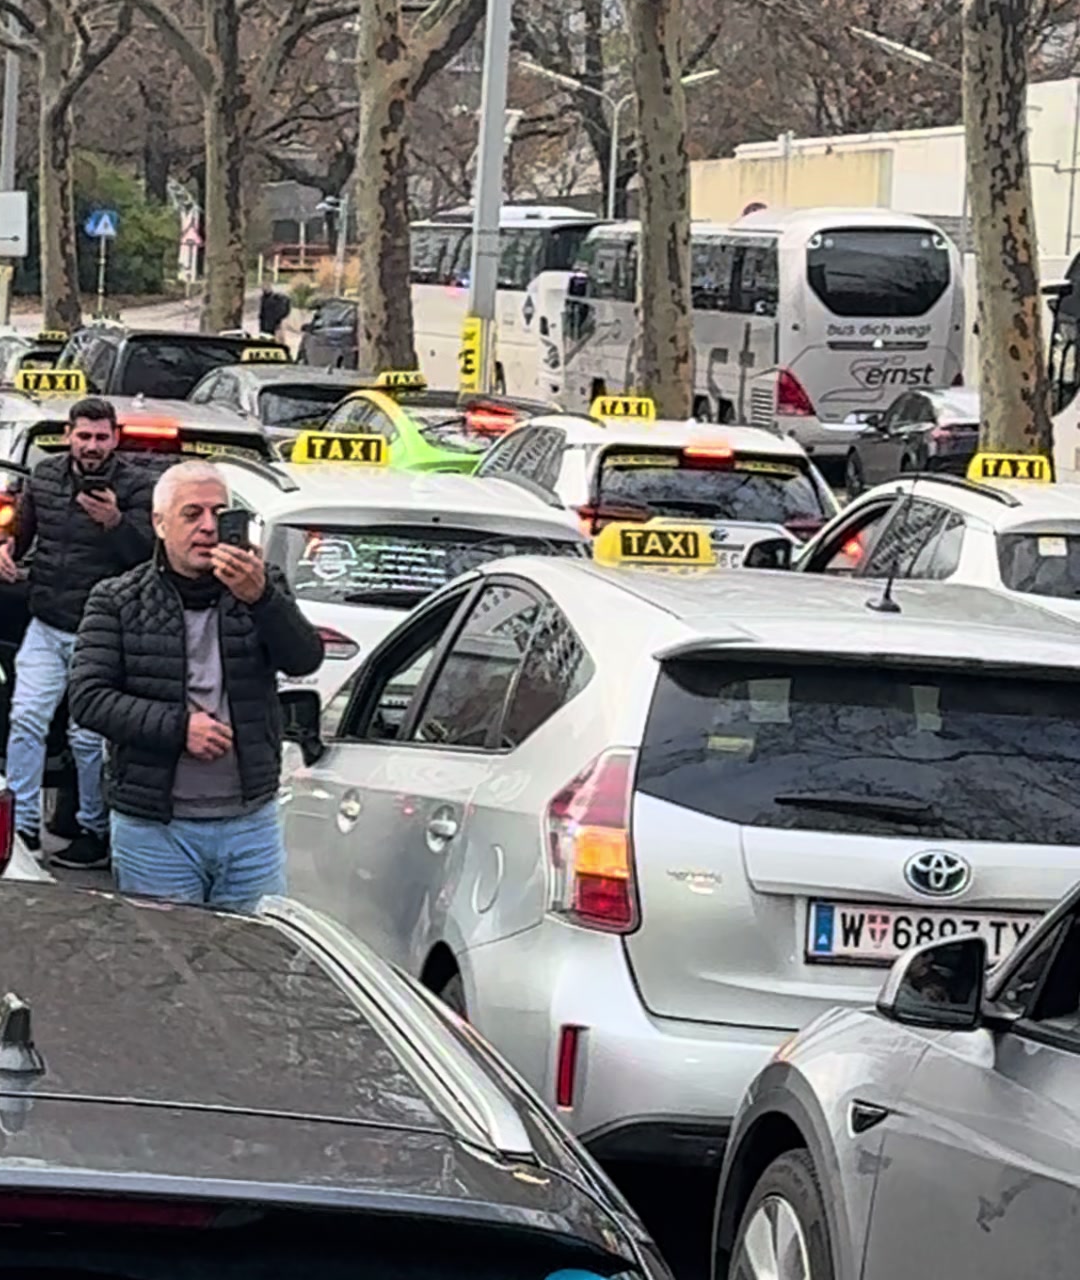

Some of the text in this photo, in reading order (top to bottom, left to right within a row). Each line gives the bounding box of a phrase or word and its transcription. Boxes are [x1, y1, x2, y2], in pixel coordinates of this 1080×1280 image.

[859, 323, 892, 336] dich
[24, 373, 80, 390] TAXI
[865, 362, 935, 385] ernst
[603, 402, 650, 417] TAXI
[312, 438, 378, 460] TAXI
[984, 460, 1042, 478] TAXI
[626, 531, 696, 557] TAXI
[840, 912, 866, 949] W
